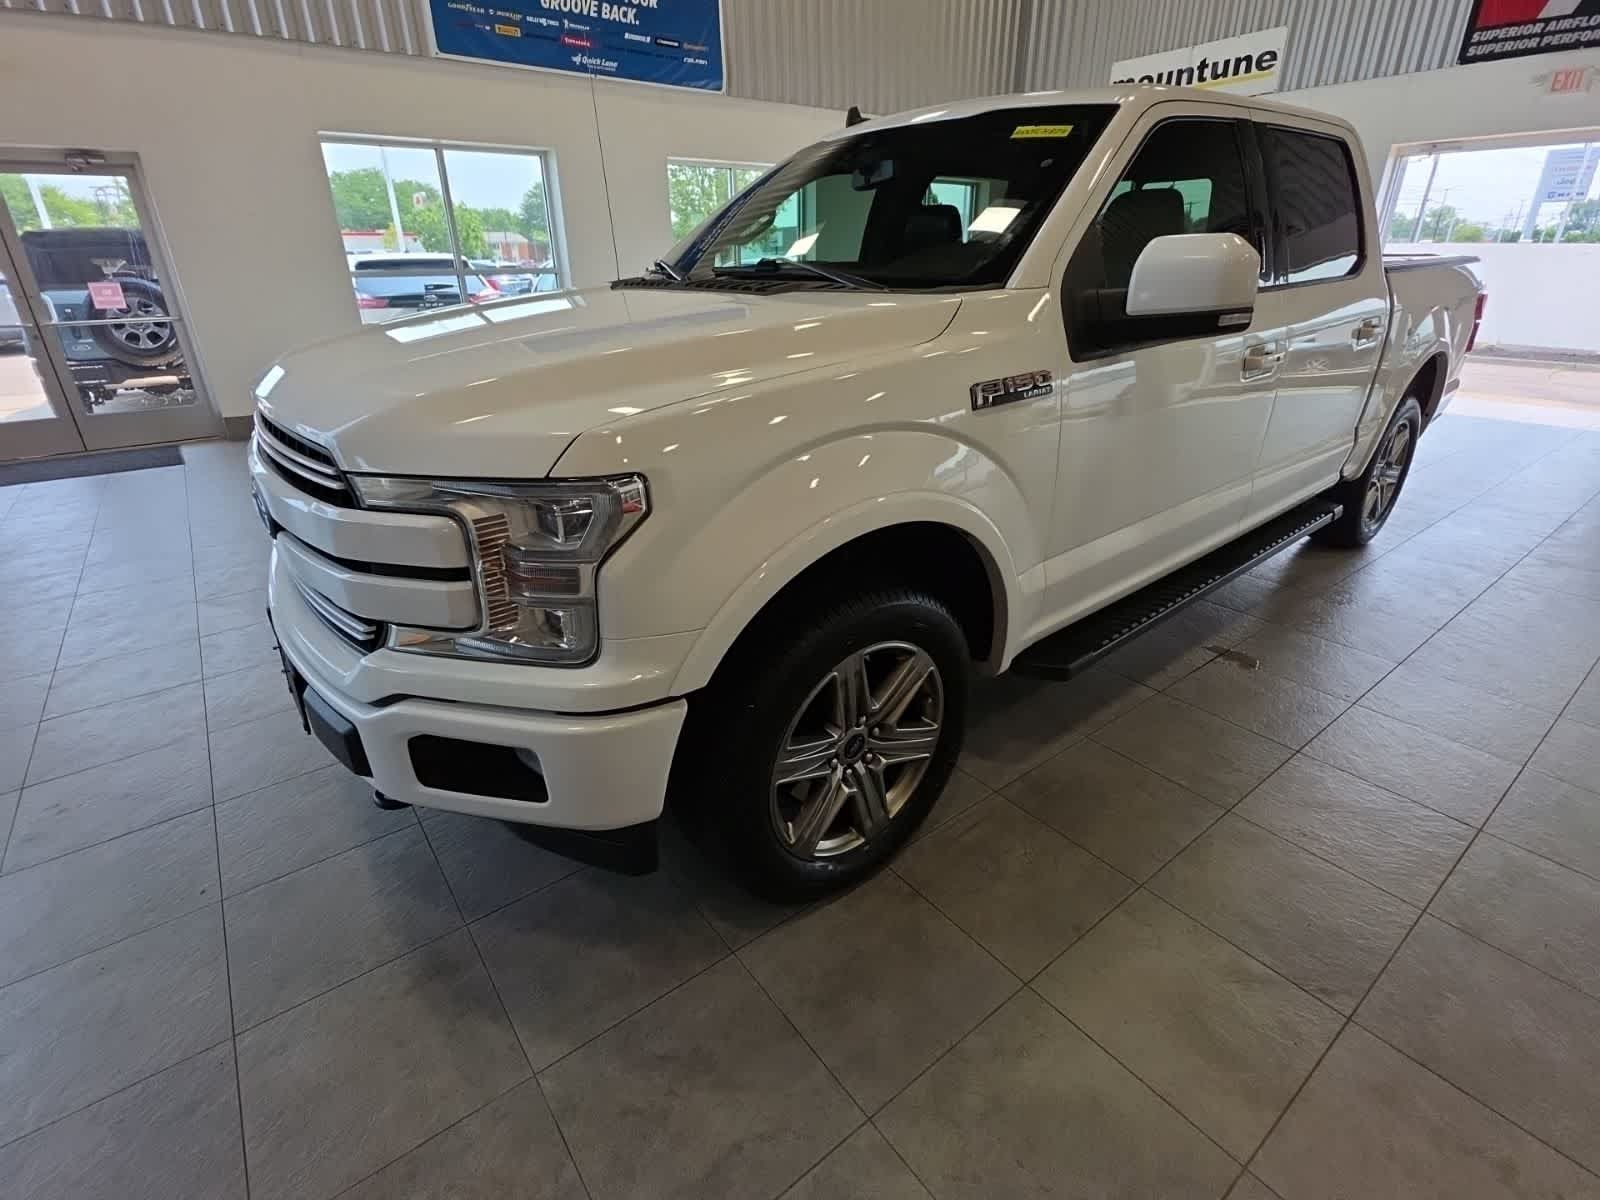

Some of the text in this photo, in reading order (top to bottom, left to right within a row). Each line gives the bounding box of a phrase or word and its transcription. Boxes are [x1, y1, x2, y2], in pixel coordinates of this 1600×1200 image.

[540, 0, 639, 25] GROOVE BACK.
[1471, 22, 1545, 43] SUPERIOR
[1466, 37, 1539, 57] SUPERIOR
[1112, 50, 1278, 87] ountune
[1550, 71, 1585, 92] EXIT
[1023, 386, 1051, 398] LARIAT
